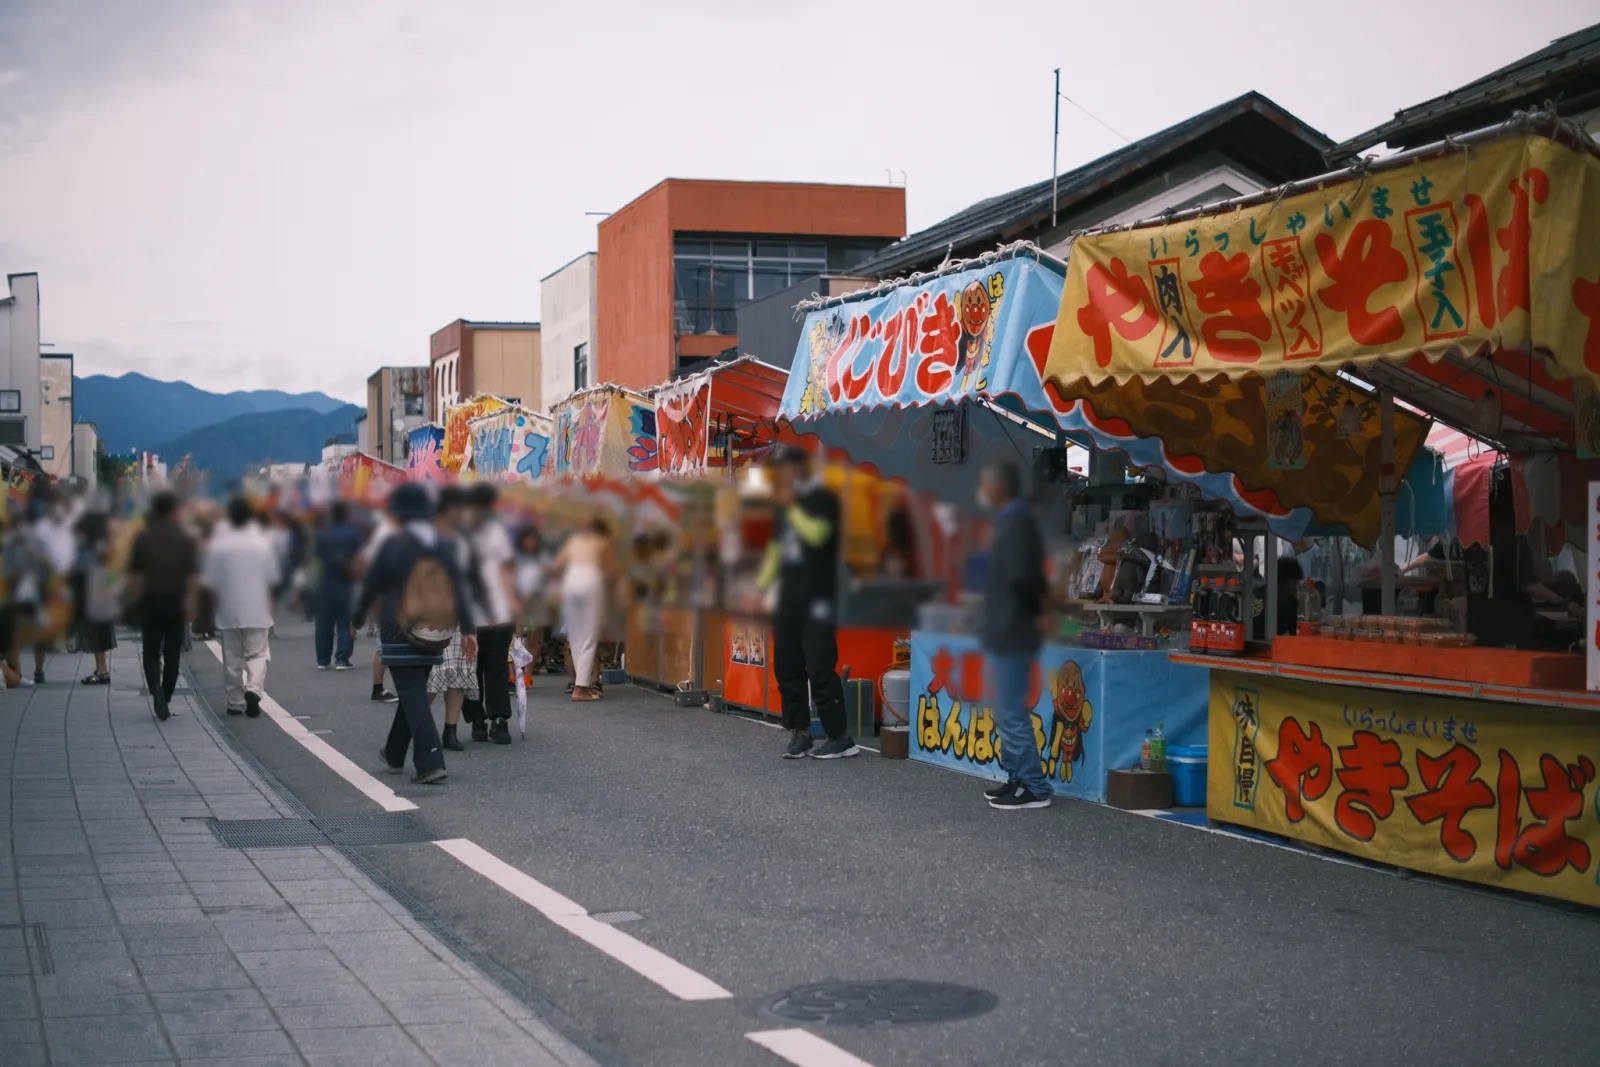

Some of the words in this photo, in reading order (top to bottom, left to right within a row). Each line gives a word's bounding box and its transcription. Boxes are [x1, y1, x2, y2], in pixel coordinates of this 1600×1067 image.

[1077, 166, 1549, 368] やきそば
[1150, 175, 1433, 260] いらっしゃいませ
[827, 291, 961, 403] くじびき
[1155, 265, 1193, 360] 肉入
[1232, 693, 1256, 804] 味自慢
[1343, 703, 1478, 744] いらっしゃいませ
[1265, 715, 1596, 877] やきそば
